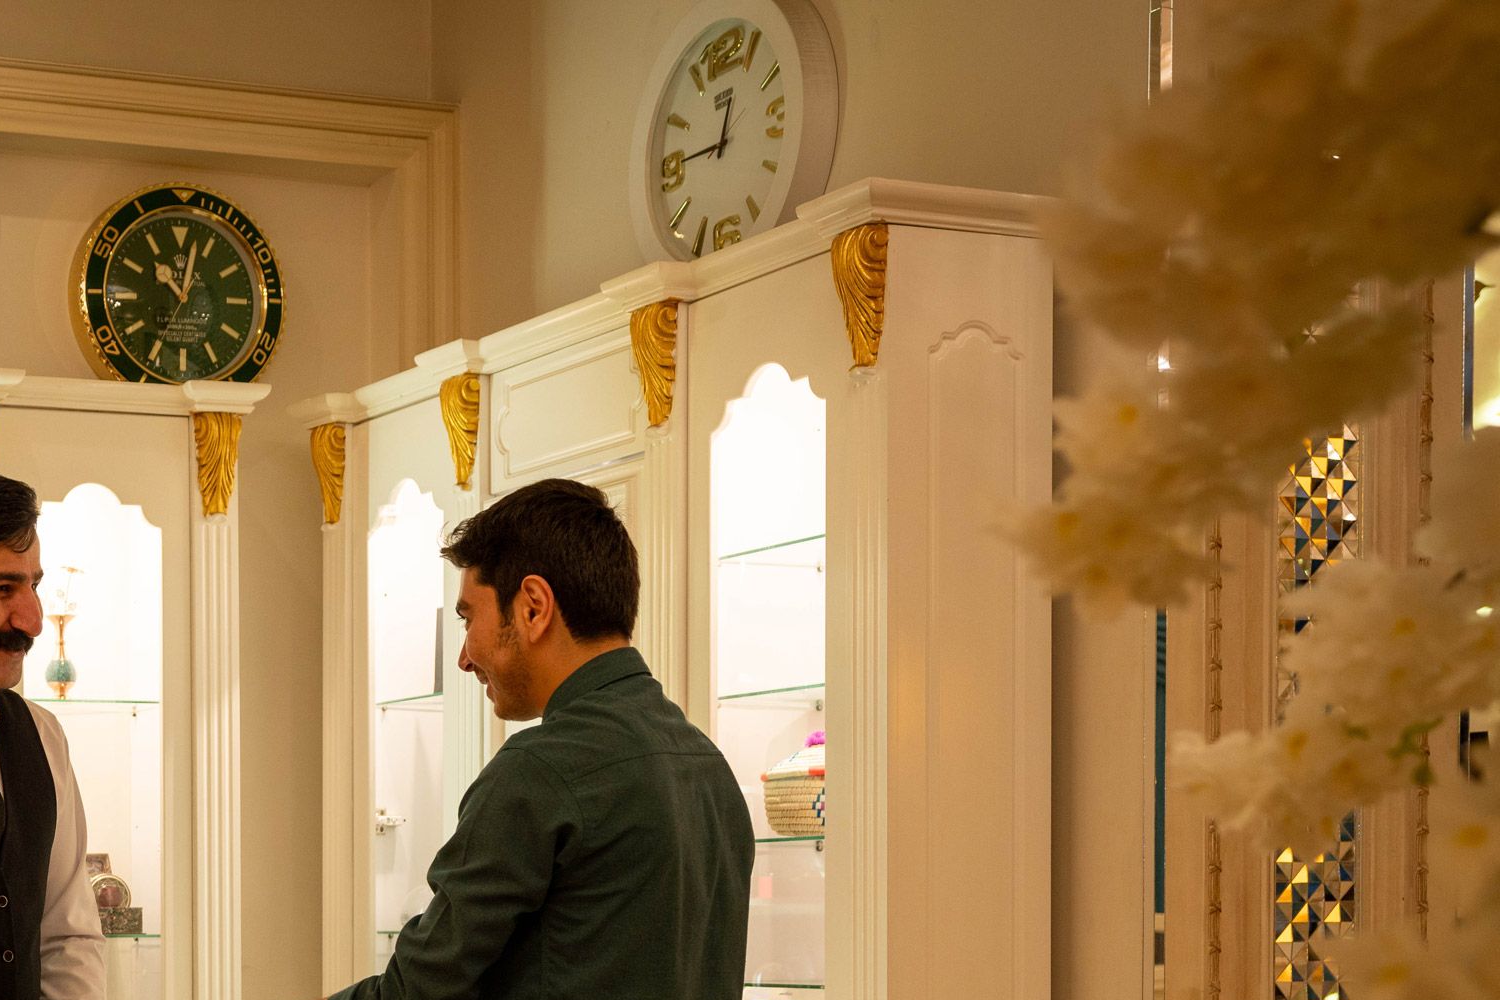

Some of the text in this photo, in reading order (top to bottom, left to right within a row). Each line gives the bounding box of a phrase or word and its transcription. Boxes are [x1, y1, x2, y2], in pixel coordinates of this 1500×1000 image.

[700, 25, 745, 82] 12
[661, 149, 686, 193] 9
[94, 226, 119, 259] 50
[714, 214, 741, 251] 6
[253, 237, 272, 265] 10
[95, 325, 121, 356] 40
[253, 332, 275, 366] 20
